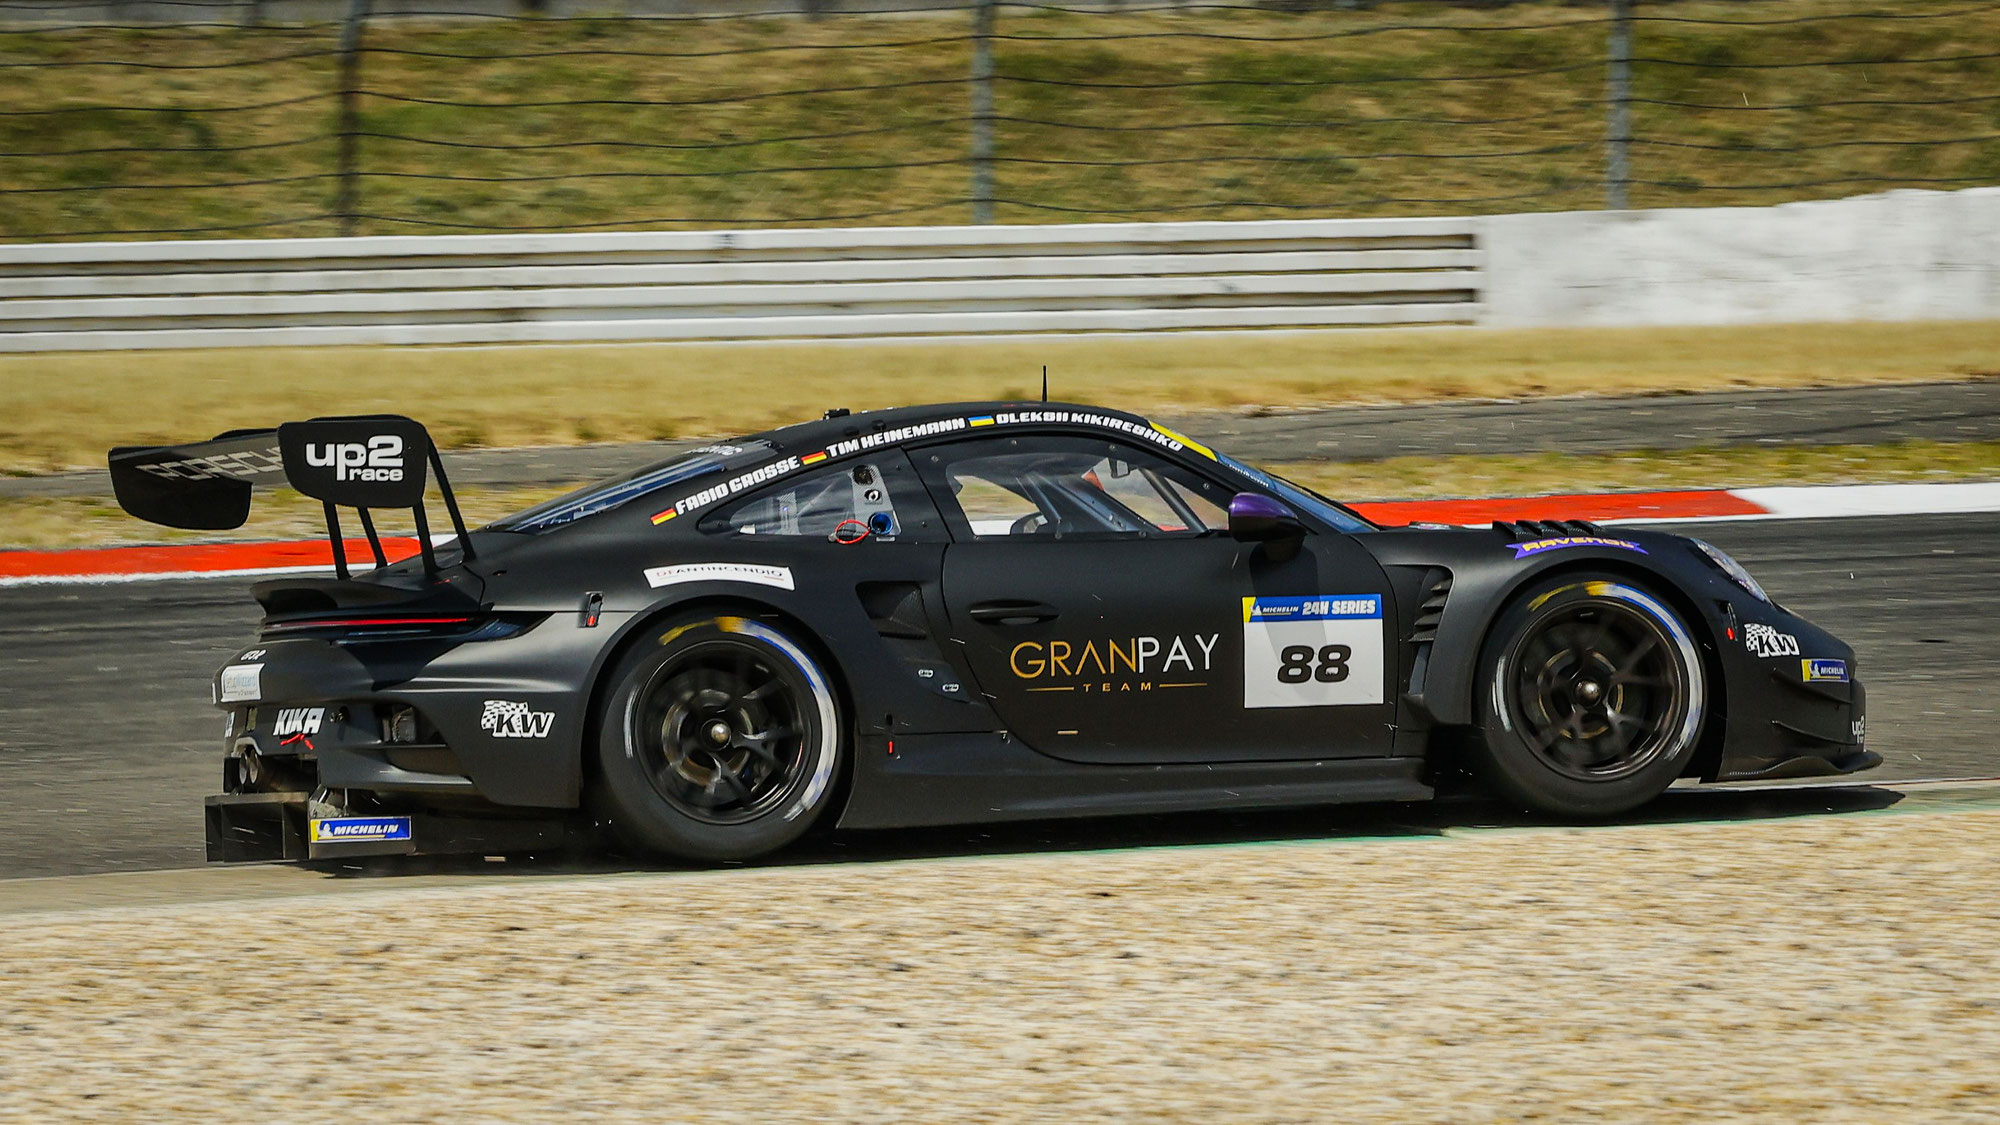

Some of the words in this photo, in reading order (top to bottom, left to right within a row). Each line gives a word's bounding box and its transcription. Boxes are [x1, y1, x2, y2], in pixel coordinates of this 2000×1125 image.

[826, 438, 860, 458] TIM
[860, 417, 966, 449] HEINEMANN
[996, 411, 1069, 425] OLEKSII
[1070, 411, 1184, 452] KIKIRESHKO
[135, 446, 284, 481] PORSCH
[305, 434, 404, 481] up2
[349, 468, 404, 482] race
[674, 483, 730, 516] FABIO
[728, 455, 801, 494] GROSSE
[1521, 536, 1636, 552] RAVENOL
[1261, 605, 1300, 614] MICHELIN
[1301, 600, 1330, 616] 24H
[1330, 599, 1377, 615] SERIES
[1009, 633, 1220, 680] GRANPAY
[1756, 633, 1800, 658] KW
[1276, 644, 1353, 685] 88
[1820, 666, 1845, 675] MICHELIN
[1083, 681, 1153, 694] TEAM
[272, 707, 326, 736] KIKA
[491, 710, 556, 738] KW
[333, 822, 400, 836] MICHELIN
